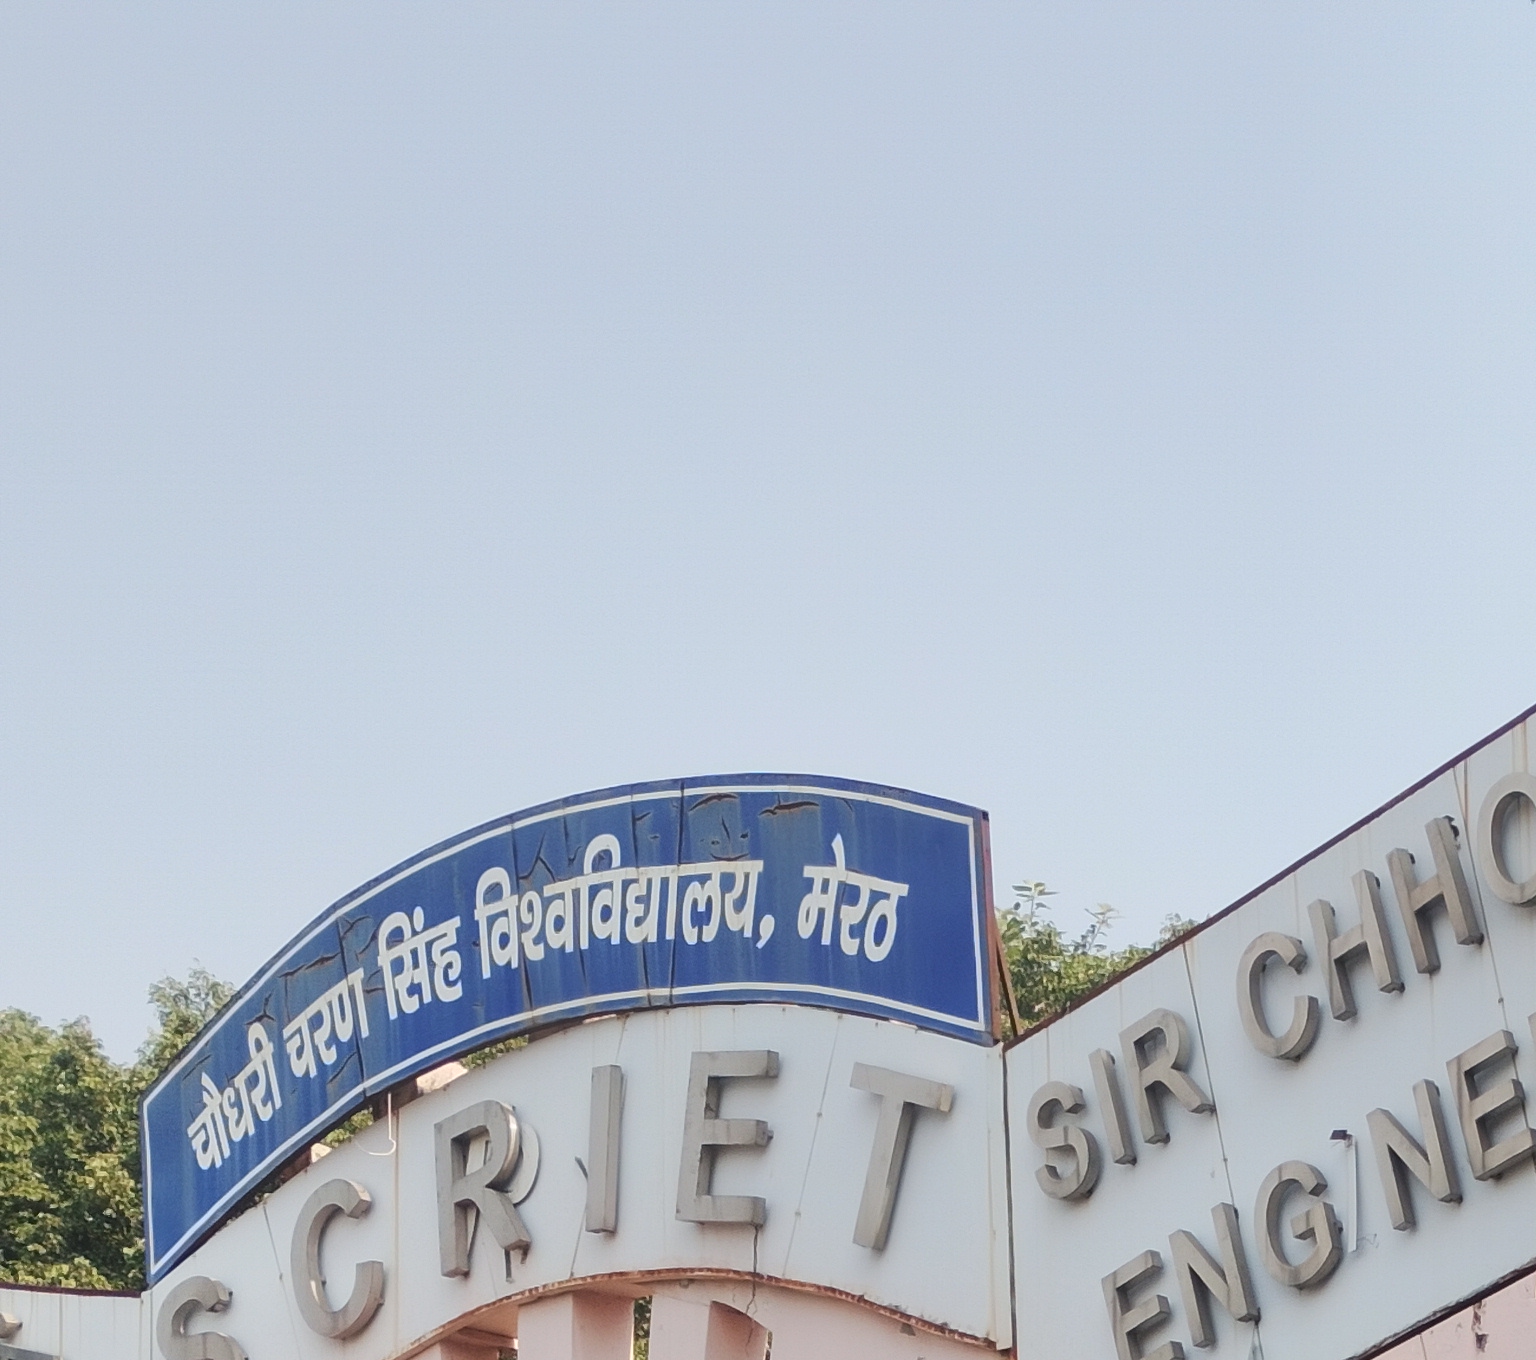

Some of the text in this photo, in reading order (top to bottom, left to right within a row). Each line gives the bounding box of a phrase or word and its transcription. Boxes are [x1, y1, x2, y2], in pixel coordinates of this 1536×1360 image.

[187, 1022, 282, 1169] चौधरी
[283, 967, 370, 1078] चरण
[378, 906, 463, 1020] सिंह
[797, 833, 909, 962] मेरठ
[1027, 1008, 1216, 1201] SIR
